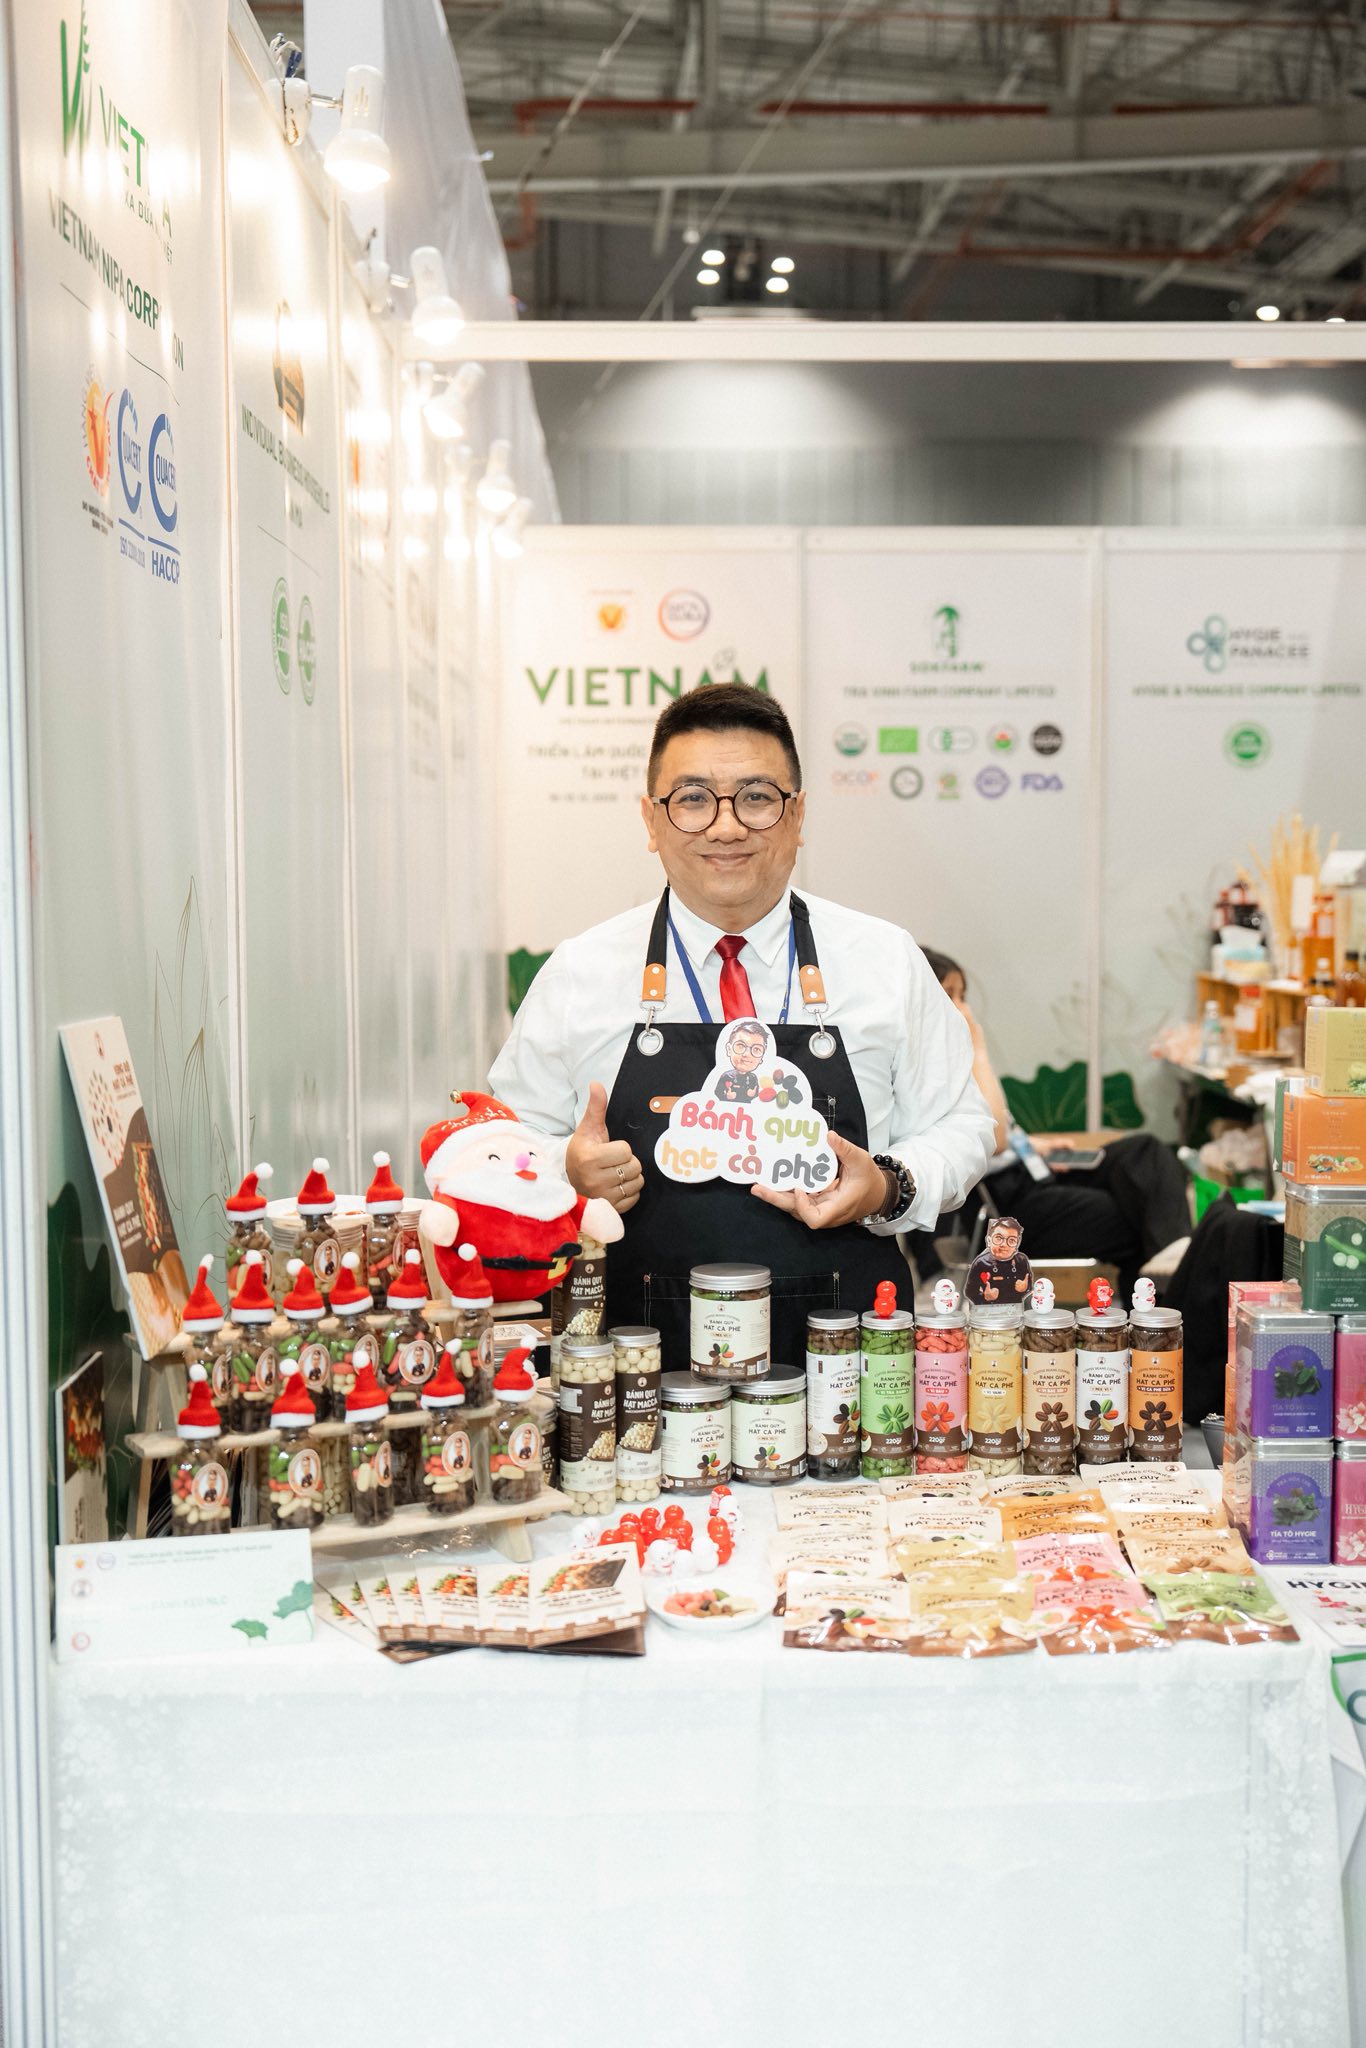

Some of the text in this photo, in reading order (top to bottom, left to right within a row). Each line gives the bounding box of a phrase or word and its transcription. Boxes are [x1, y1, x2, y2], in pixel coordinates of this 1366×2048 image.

[102, 248, 126, 306] NIPA
[151, 550, 180, 584] HACCP
[681, 1099, 821, 1147] Bánh quy
[661, 1139, 831, 1189] hạt cà phê
